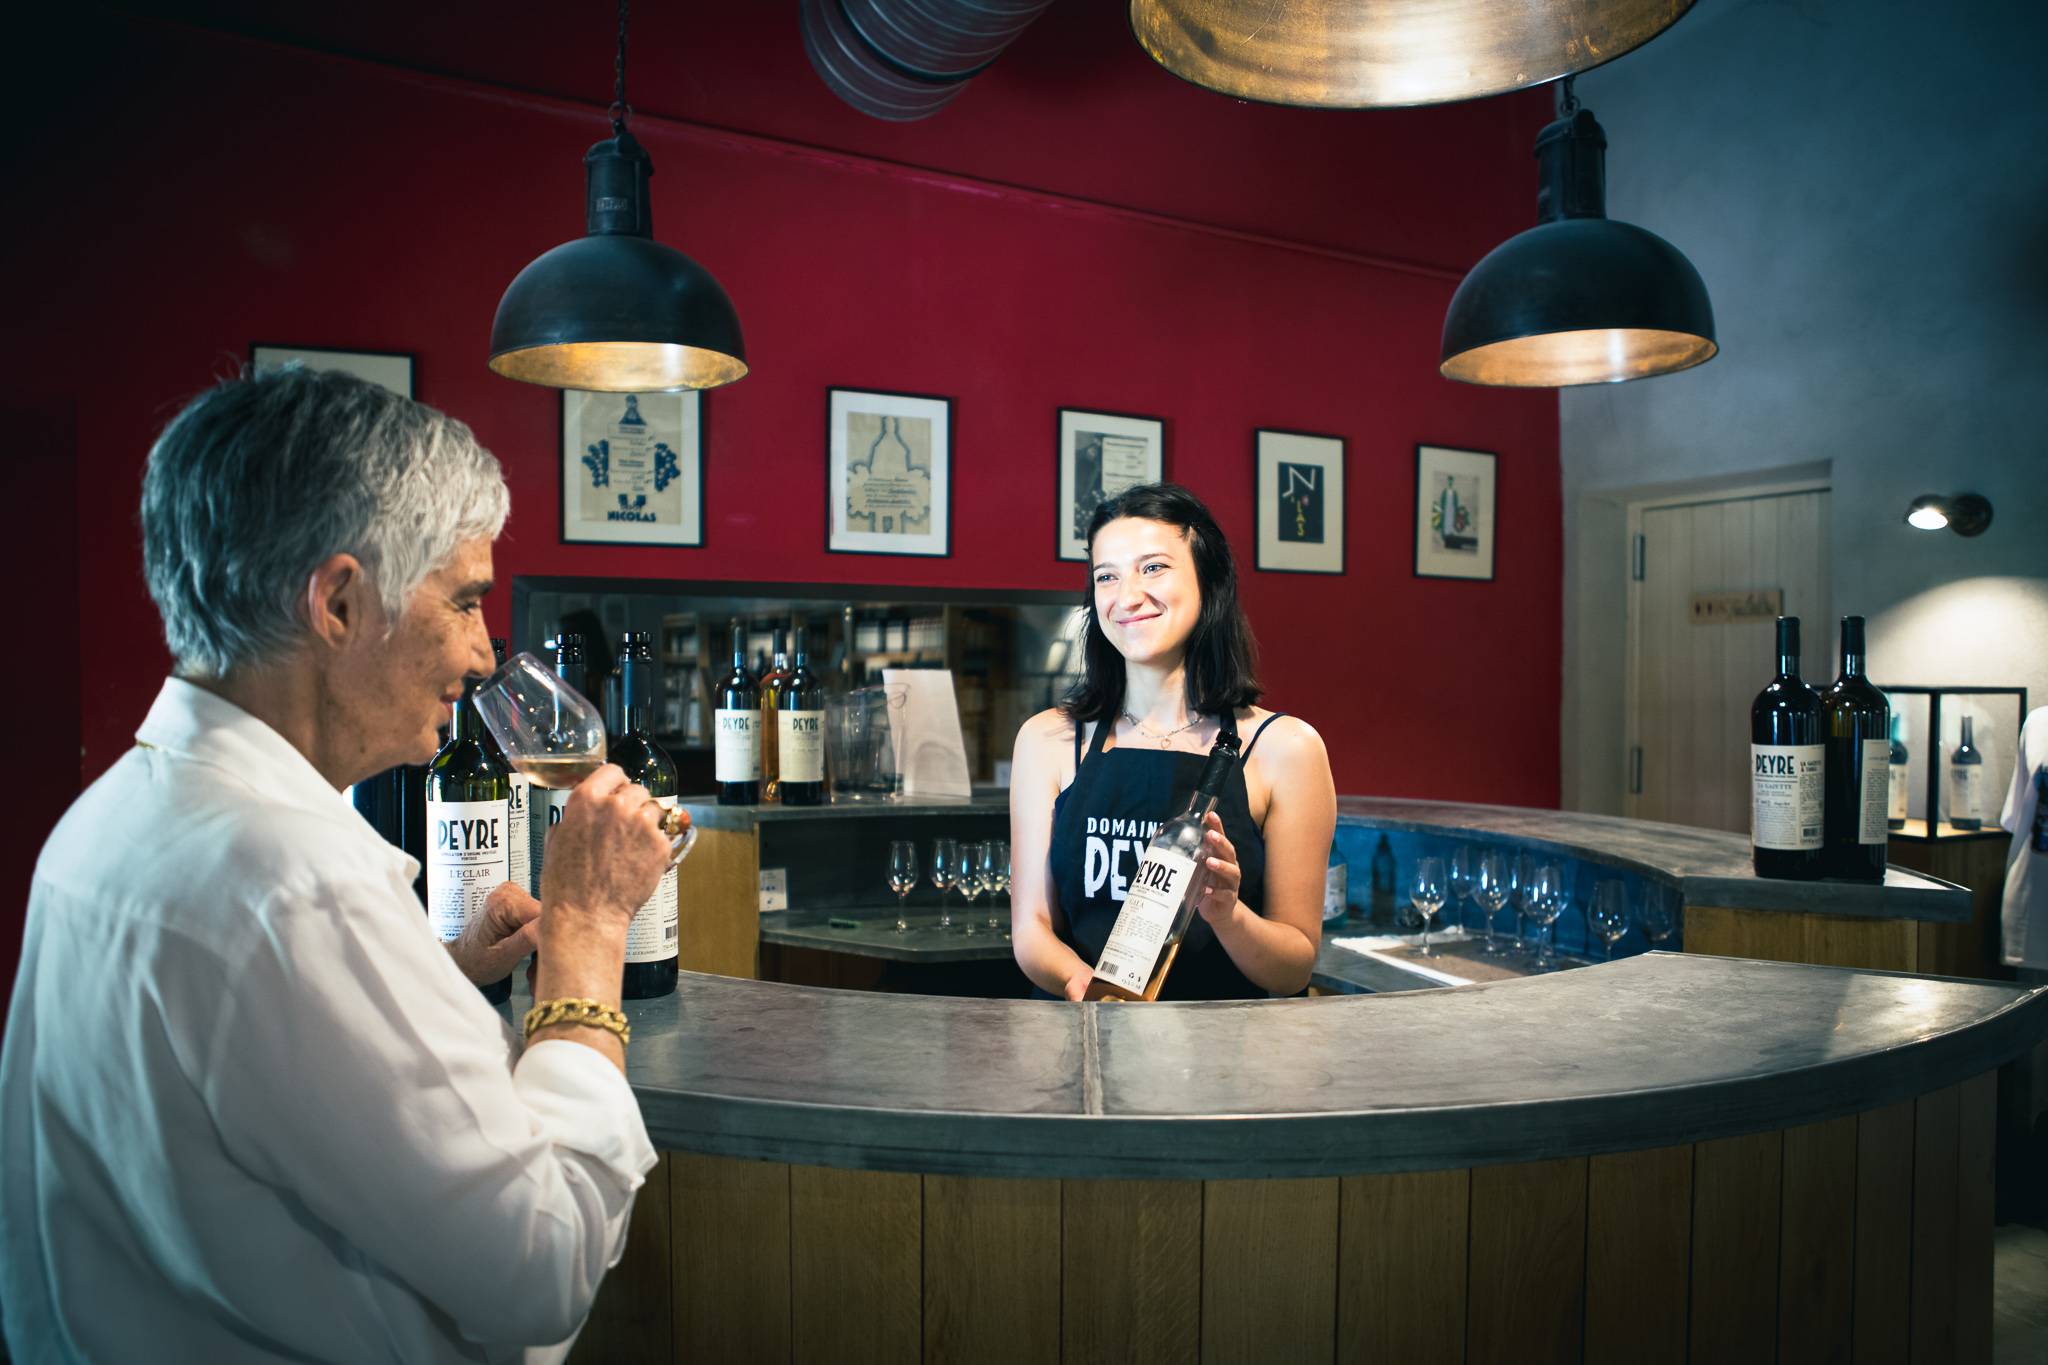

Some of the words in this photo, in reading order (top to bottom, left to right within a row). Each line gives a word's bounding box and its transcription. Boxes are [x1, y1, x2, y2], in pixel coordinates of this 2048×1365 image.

[607, 511, 656, 522] NICOLAS
[723, 718, 749, 730] PEYRE
[793, 717, 818, 730] PEYRE
[1756, 754, 1794, 774] PEYRE
[438, 818, 498, 850] PEYRE
[1136, 860, 1177, 893] EYRE
